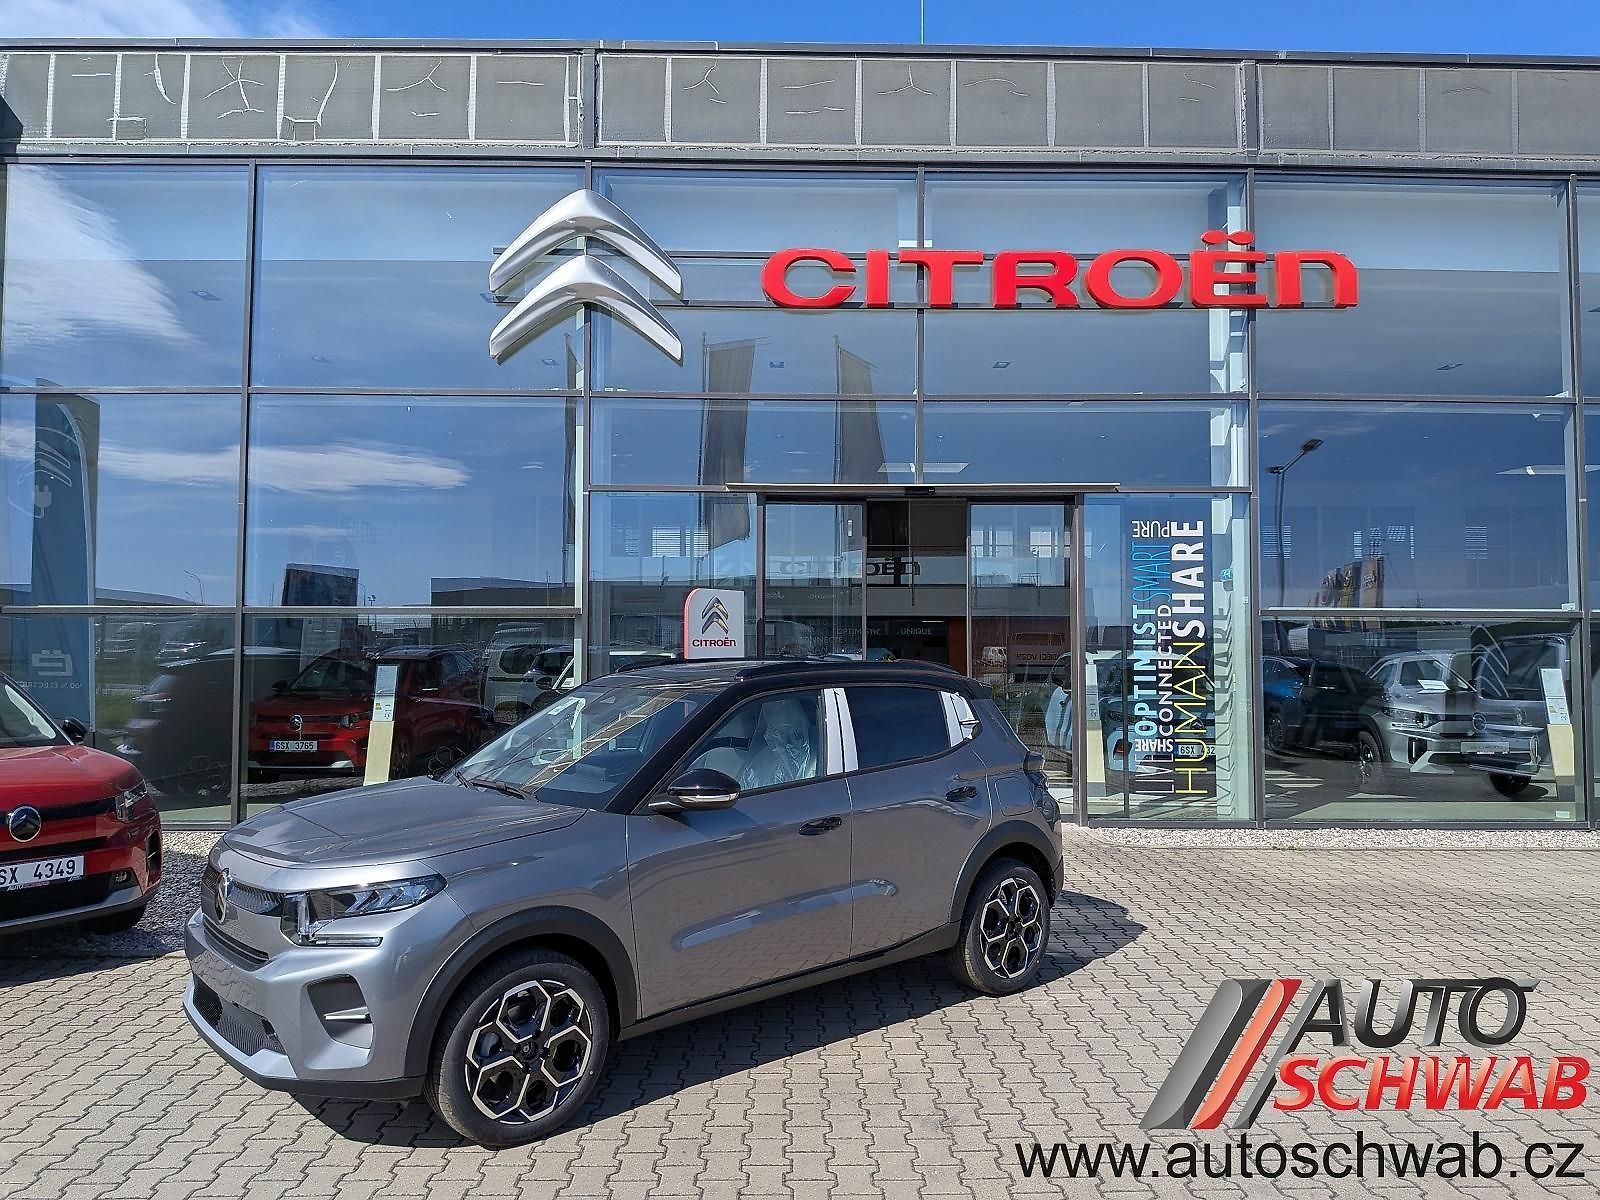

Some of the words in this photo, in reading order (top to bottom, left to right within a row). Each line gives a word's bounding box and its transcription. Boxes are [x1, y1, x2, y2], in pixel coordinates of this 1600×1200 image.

[761, 230, 1359, 308] CITROËN
[1132, 520, 1170, 538] PURE
[1132, 541, 1171, 603] SMART
[1171, 520, 1206, 639] SHARE
[1133, 604, 1158, 736] OPTIMIST
[1158, 604, 1174, 737] CONNECTED
[1135, 739, 1174, 752] SHARE
[1173, 642, 1208, 793] HUMAN
[1135, 753, 1174, 793] LIVE
[1180, 746, 1195, 755] 6SX
[33, 859, 76, 880] 4349
